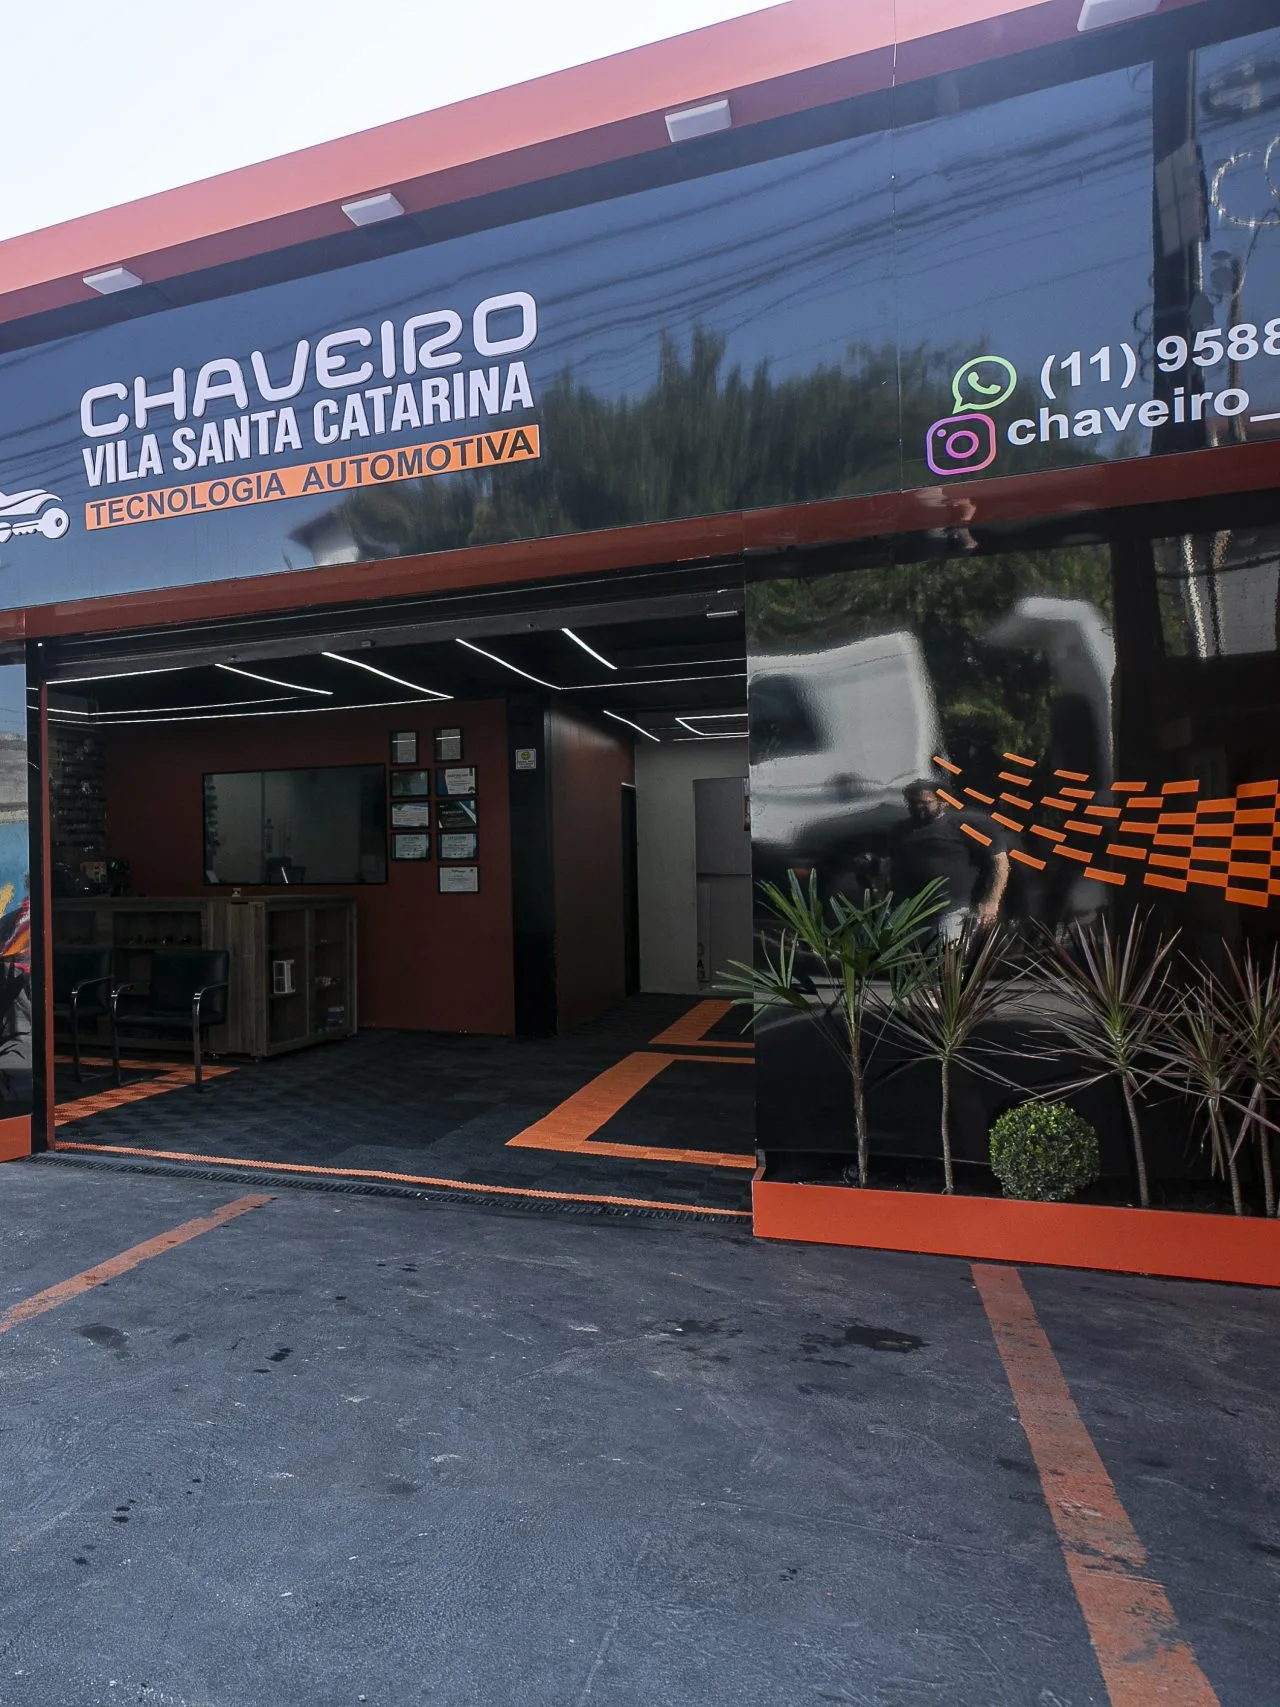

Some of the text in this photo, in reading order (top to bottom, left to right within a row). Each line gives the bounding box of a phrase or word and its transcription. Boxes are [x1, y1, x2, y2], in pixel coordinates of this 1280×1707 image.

[81, 291, 537, 438] CHAVEIRO
[1040, 343, 1137, 400] (11)
[82, 361, 535, 487] VILA SANTA CATARINA
[1007, 386, 1280, 446] chaveiro_
[90, 430, 535, 526] TECNOLOGIA AUTOMOTIVA
